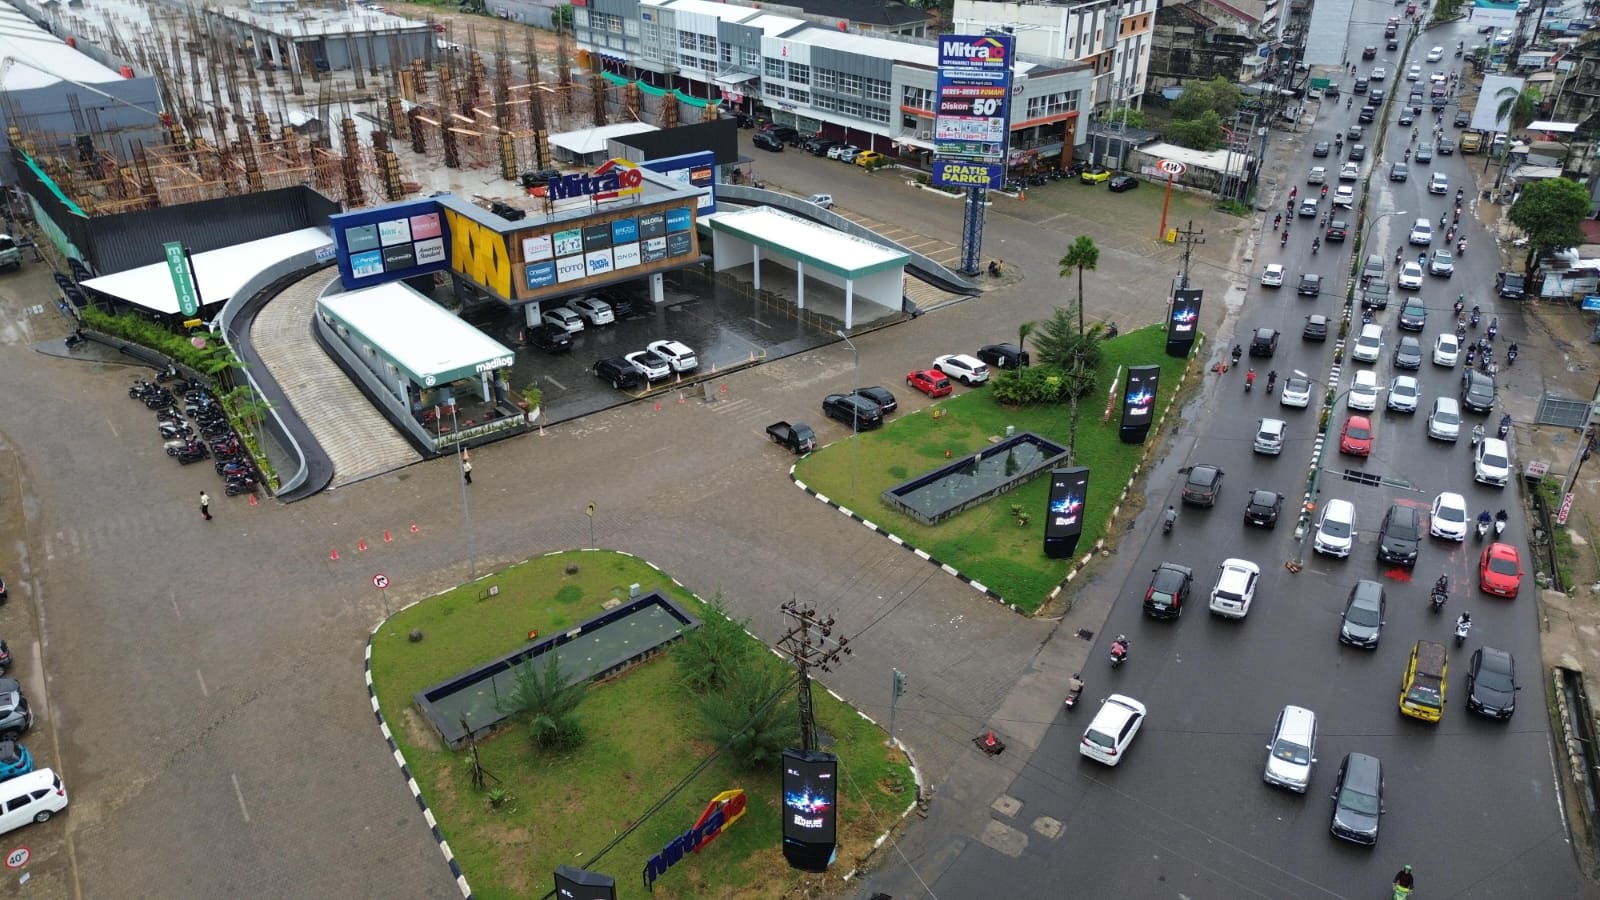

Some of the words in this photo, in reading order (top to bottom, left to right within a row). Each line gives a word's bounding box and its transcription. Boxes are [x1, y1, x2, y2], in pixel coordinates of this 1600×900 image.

[943, 41, 1005, 58] Mitra10
[941, 102, 969, 111] Diskon
[944, 165, 988, 176] GRATIS
[942, 173, 991, 184] PARKIR
[549, 168, 643, 201] Mitra10
[560, 263, 584, 274] TOTO
[475, 356, 513, 373] madilog
